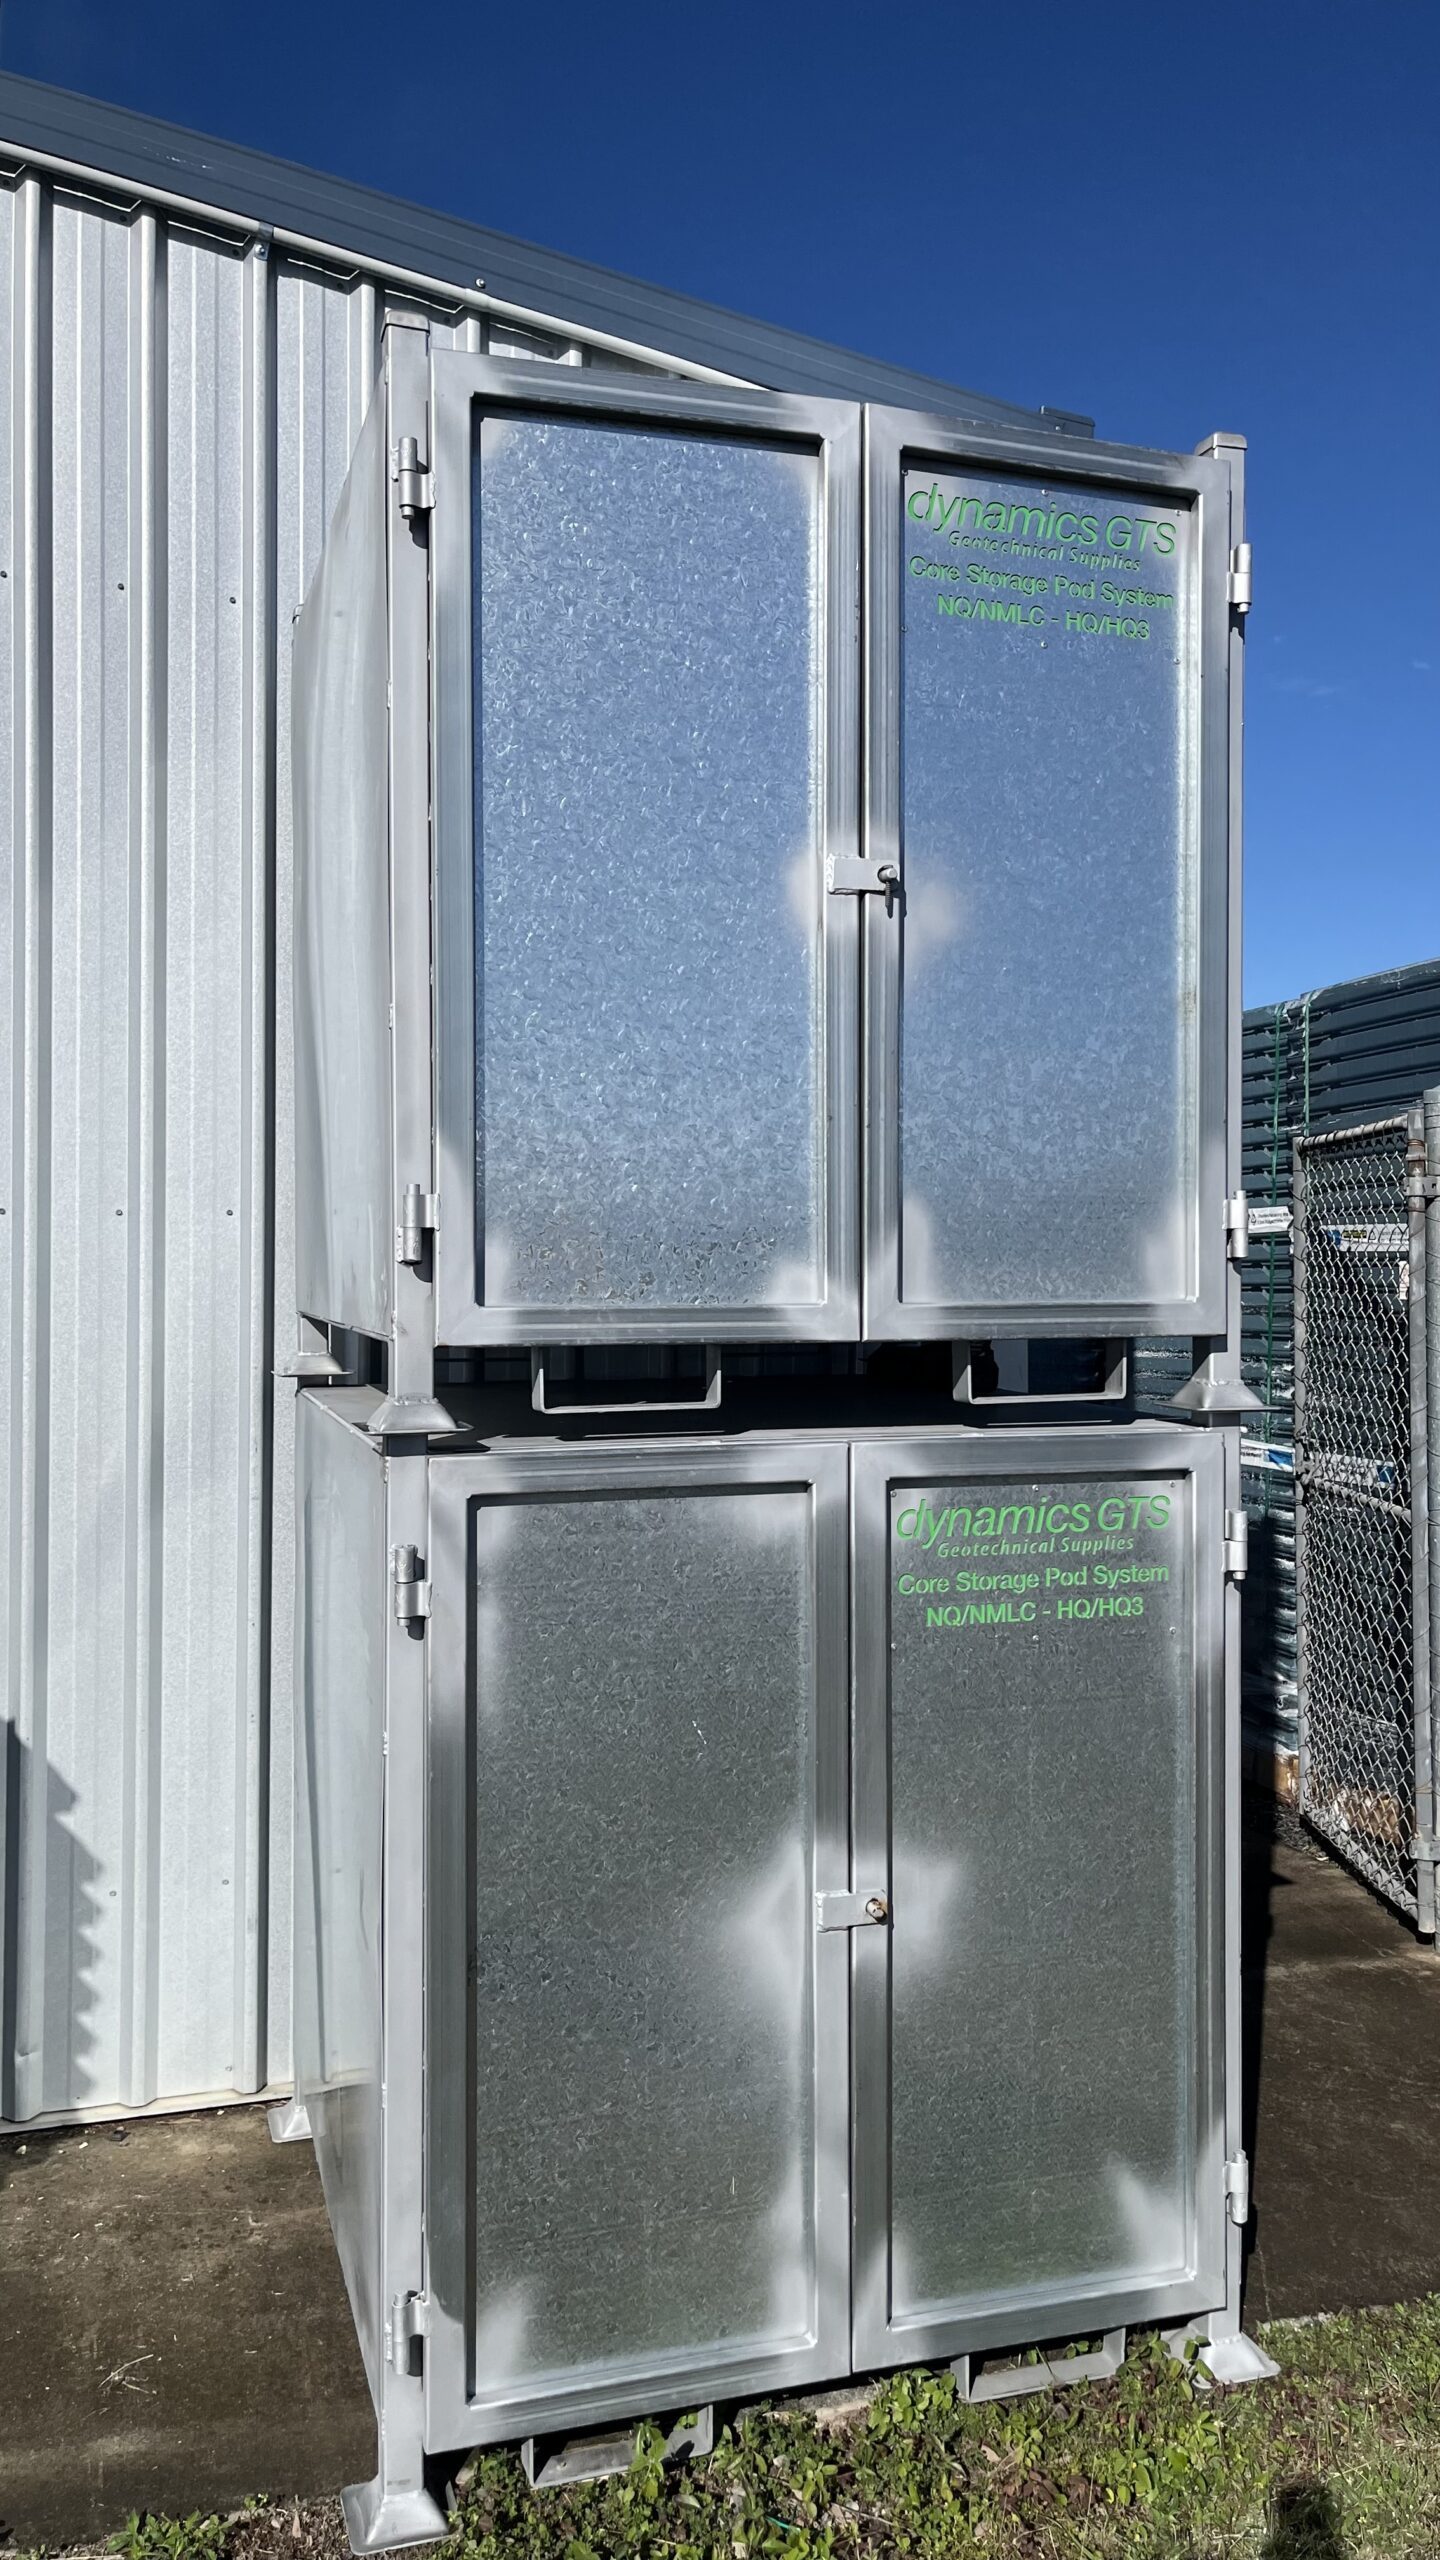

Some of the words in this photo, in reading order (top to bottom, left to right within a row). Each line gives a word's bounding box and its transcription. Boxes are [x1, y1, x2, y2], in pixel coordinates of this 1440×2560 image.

[907, 483, 1098, 545] dynamics
[1105, 515, 1177, 556] GTS
[949, 530, 1064, 561] Geotechnical
[1069, 547, 1141, 571] Supplies
[909, 556, 960, 583] Core
[966, 563, 1047, 597] Storage
[1054, 575, 1095, 600] Pod
[1100, 581, 1173, 608] System
[937, 594, 1045, 626] NQ/NMLC
[1066, 609, 1150, 640] HQ/HQ3
[896, 1496, 1091, 1549] dynamics
[1098, 1495, 1171, 1531] GTS
[937, 1536, 1055, 1558] Geotechnical
[1061, 1535, 1134, 1555] Supplies
[898, 1573, 949, 1596] Core
[956, 1570, 1039, 1593] Storage
[1045, 1565, 1087, 1587] Pod
[1093, 1563, 1169, 1588] System
[926, 1602, 1036, 1627] NQ/NMLC
[1057, 1597, 1144, 1620] HQ/HQ3
